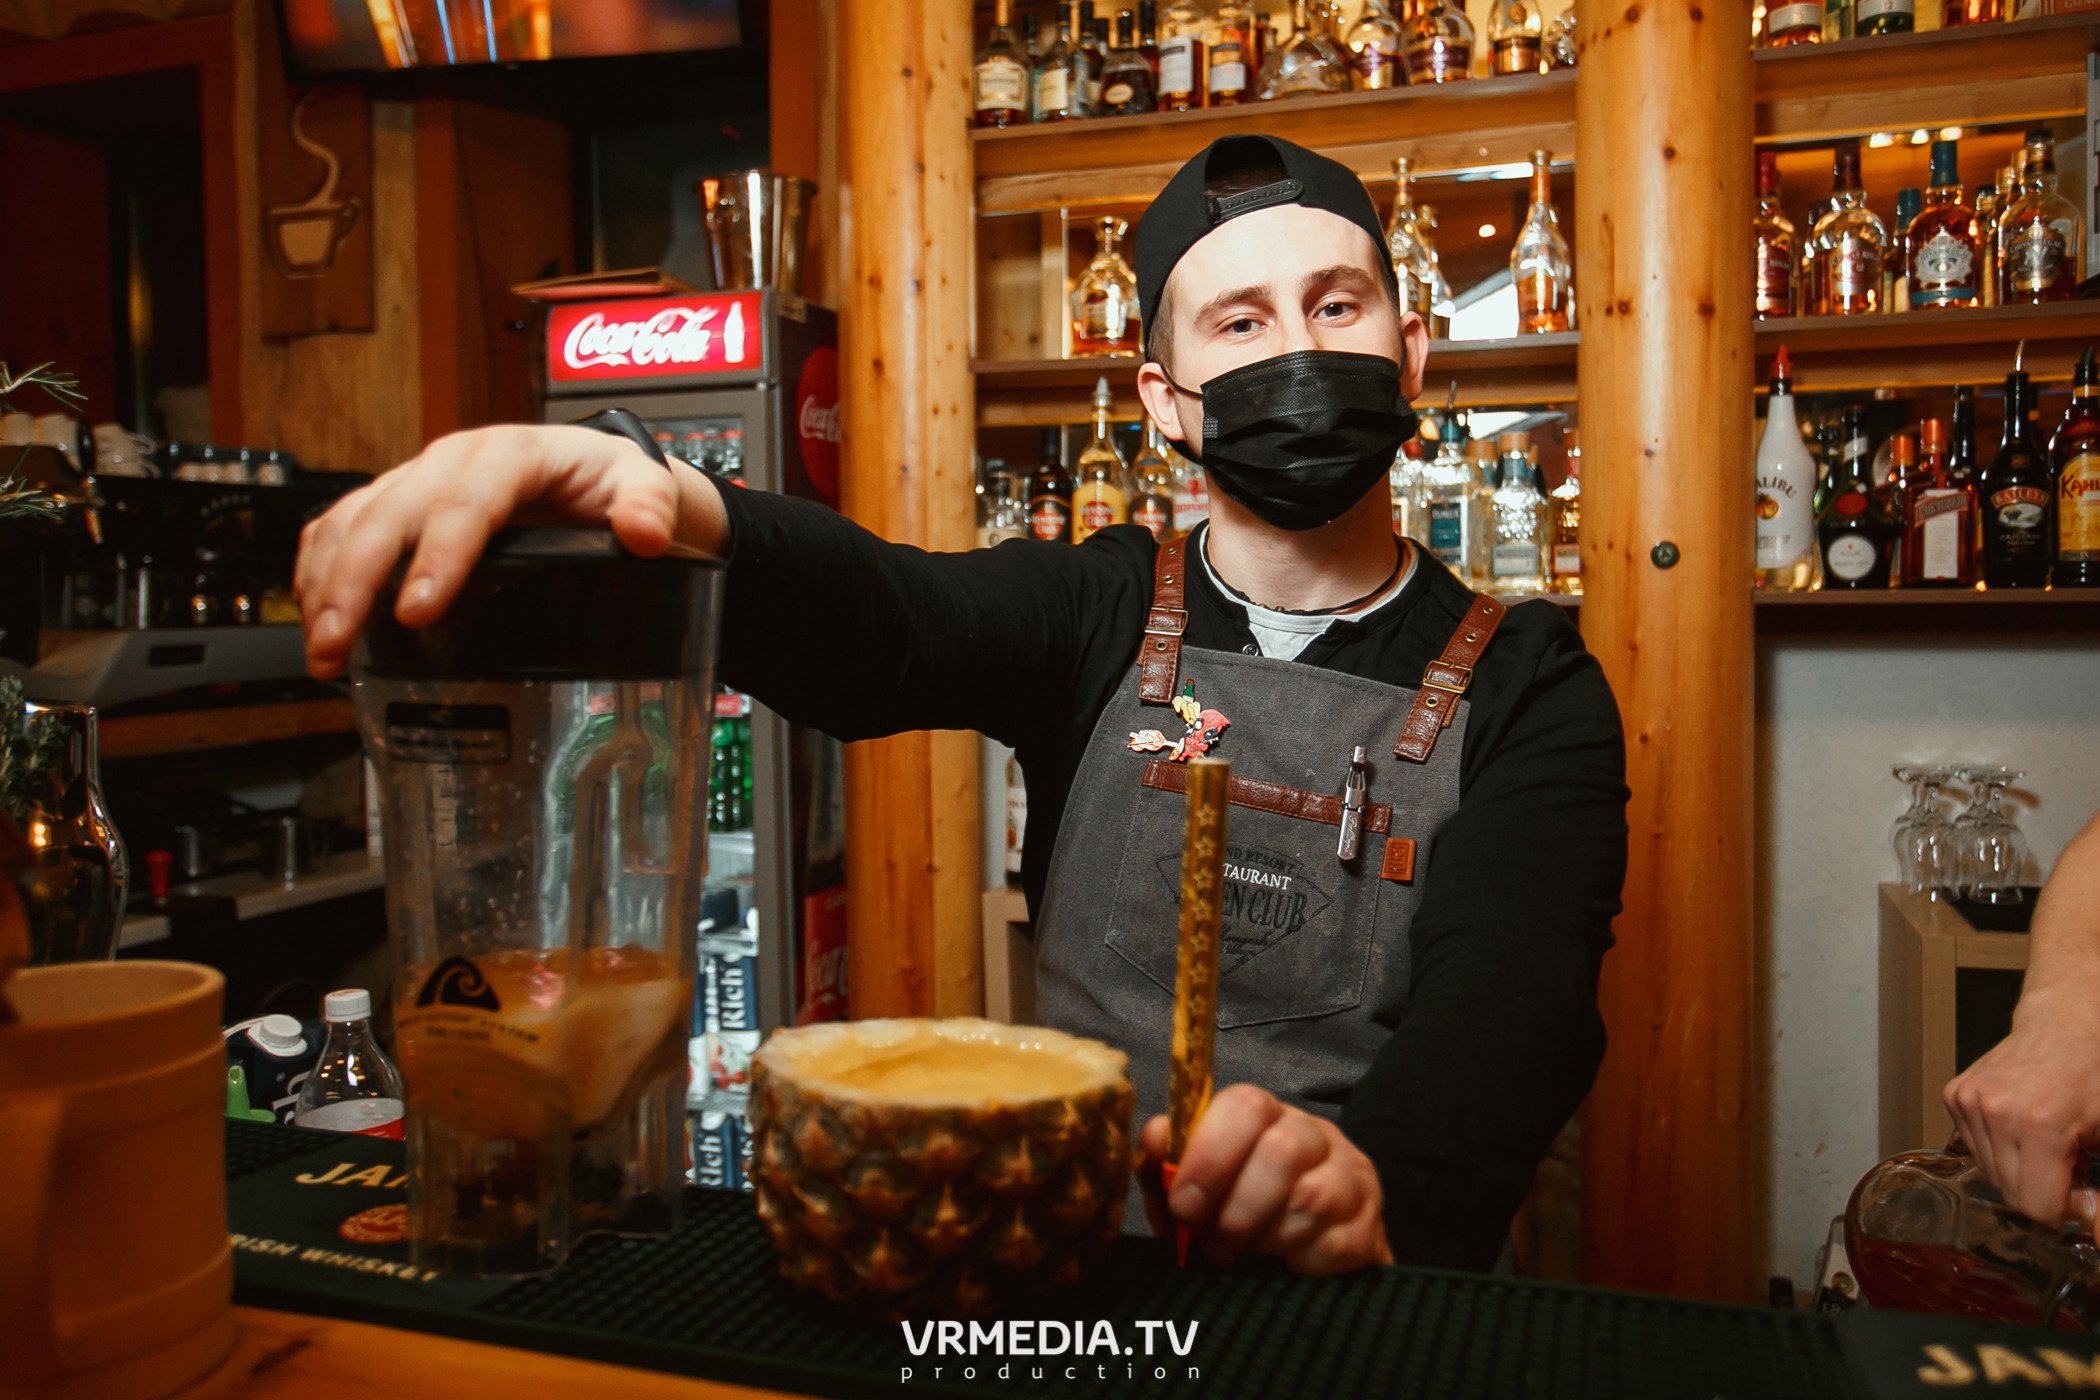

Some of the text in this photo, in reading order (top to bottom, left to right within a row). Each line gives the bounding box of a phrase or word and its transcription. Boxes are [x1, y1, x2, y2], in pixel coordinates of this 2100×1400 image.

[564, 307, 718, 369] Coca-Cola
[1995, 488, 2045, 504] BAILEYS
[2061, 475, 2100, 499] KAHL
[1246, 852, 1294, 875] RESORT
[1222, 863, 1291, 890] TAURANT
[1249, 887, 1308, 933] CLUB
[720, 966, 746, 1030] Rich
[230, 1233, 299, 1256] RISH
